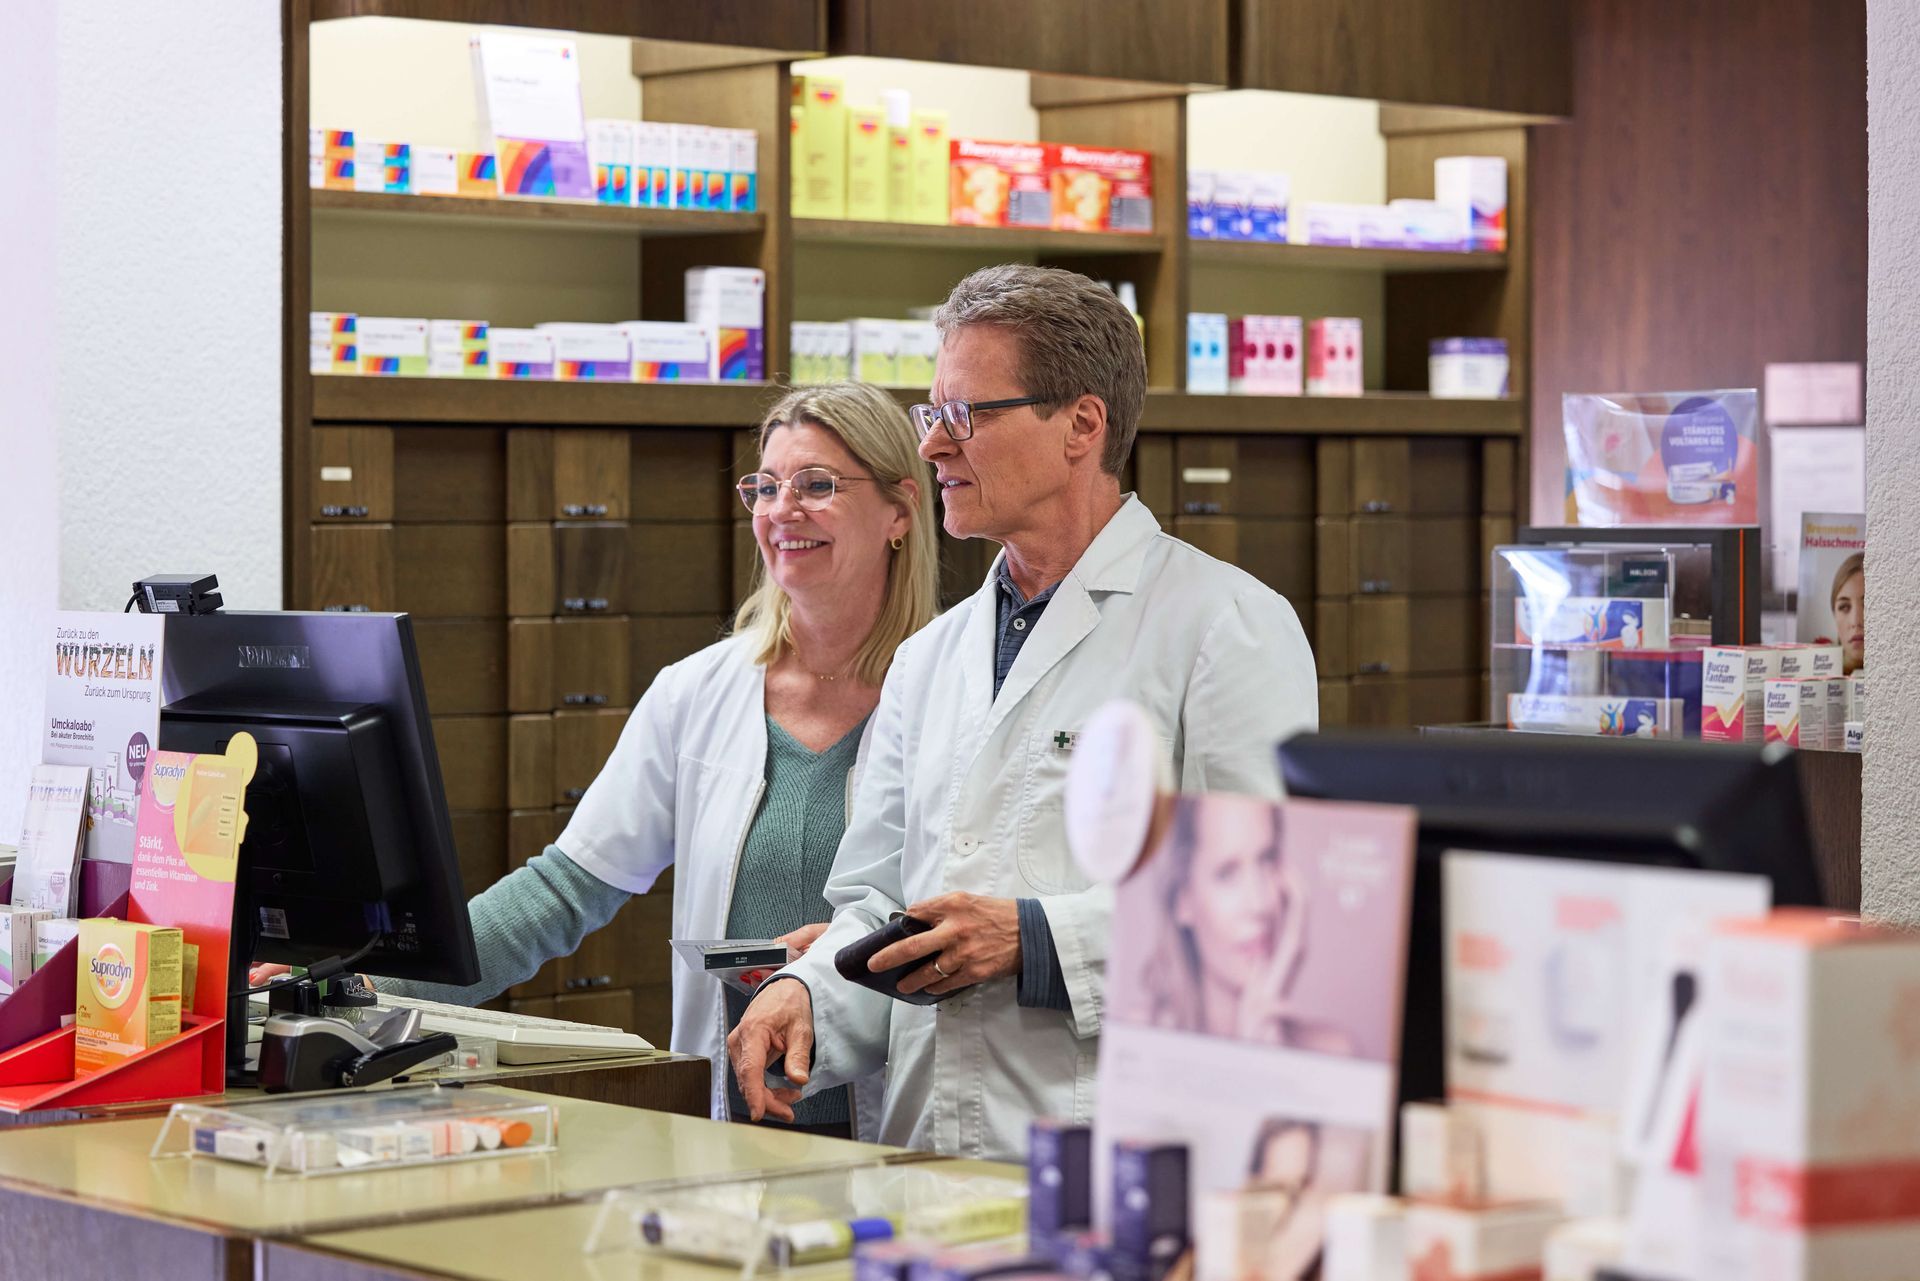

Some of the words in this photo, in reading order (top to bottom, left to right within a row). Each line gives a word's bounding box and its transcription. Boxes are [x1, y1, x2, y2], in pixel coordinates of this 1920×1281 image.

[57, 627, 77, 639] Zurück
[79, 631, 86, 640] zu
[87, 630, 99, 640] den
[56, 642, 154, 680] WURZELN
[1707, 661, 1730, 675] Bucco
[1705, 672, 1736, 684] Tantum
[84, 685, 106, 698] Zurück
[107, 688, 120, 698] zum
[121, 687, 151, 702] Ursprung
[1768, 691, 1786, 702] Bucco
[1766, 699, 1791, 709] Tantum
[58, 732, 73, 740] akuter
[73, 733, 95, 741] Bronchitis
[129, 744, 147, 759] NEU
[154, 763, 186, 780] Supradyn
[139, 835, 164, 852] Stärkt,
[137, 851, 151, 862] dank
[152, 853, 165, 864] dem
[165, 855, 177, 866] Plus
[178, 859, 186, 867] an
[136, 867, 169, 878] essentiellen
[169, 869, 198, 882] Vitaminen
[134, 880, 146, 889] und
[91, 958, 132, 980] Supradyn
[105, 980, 116, 988] pro
